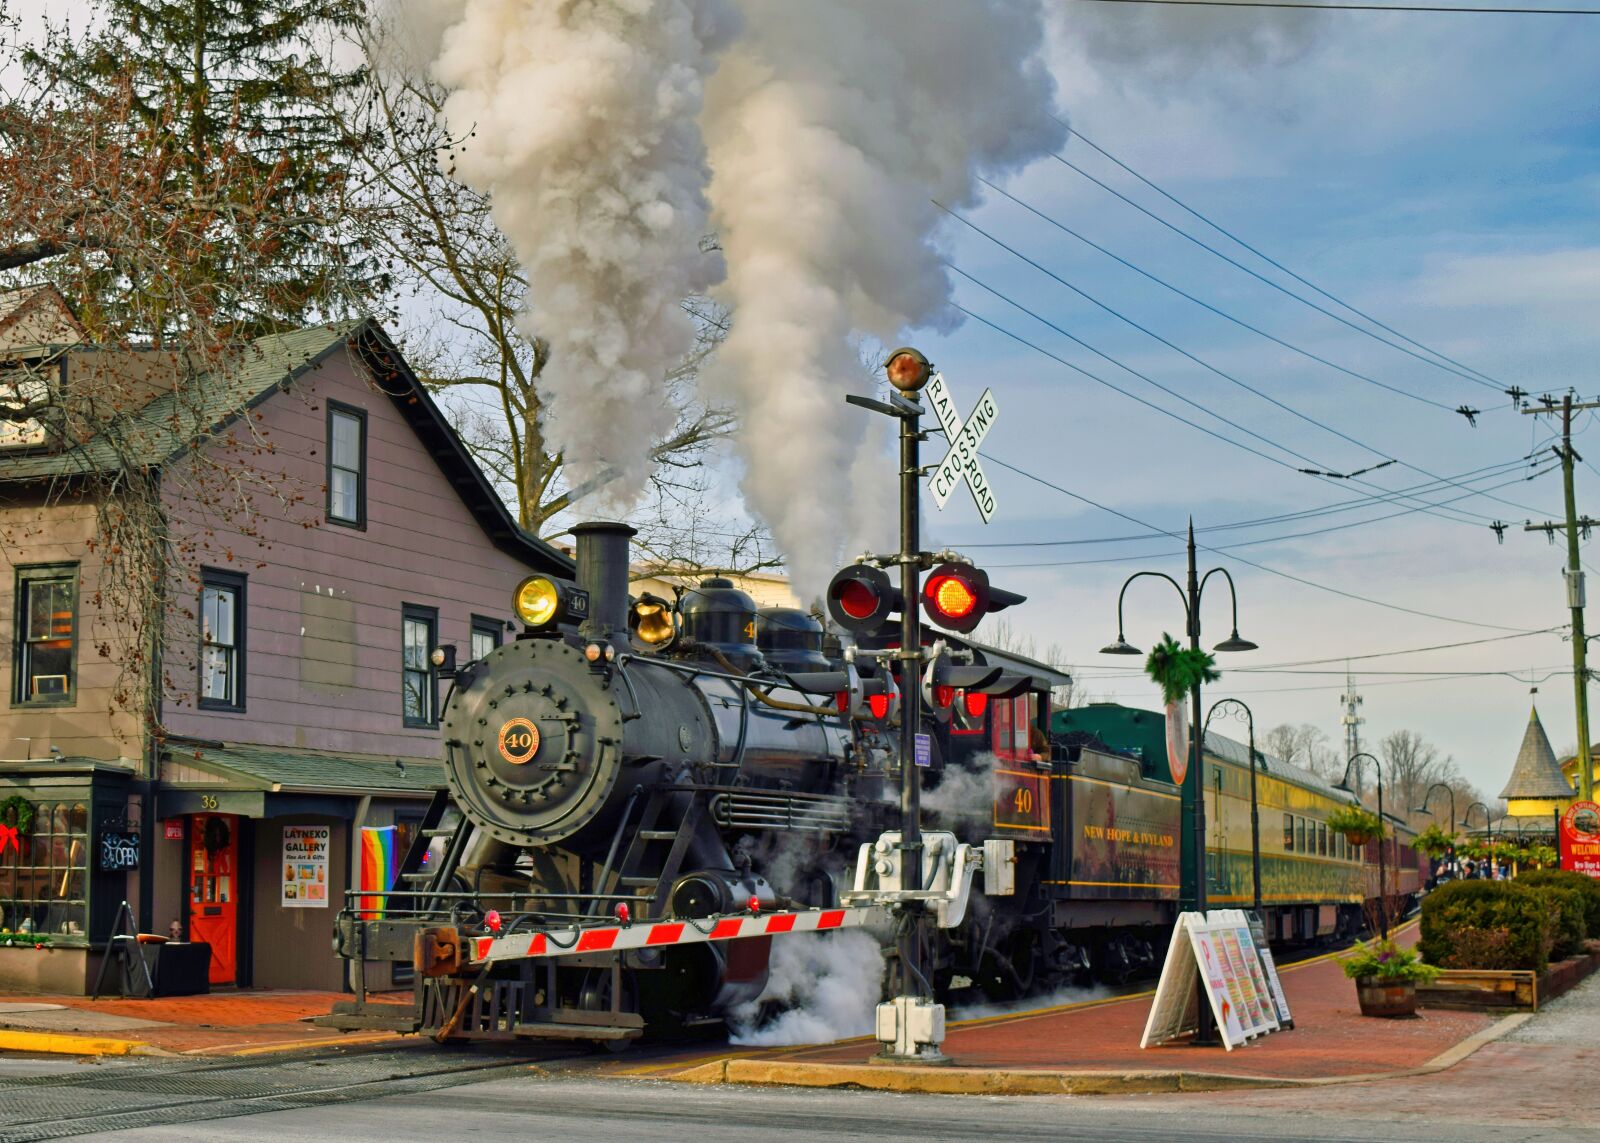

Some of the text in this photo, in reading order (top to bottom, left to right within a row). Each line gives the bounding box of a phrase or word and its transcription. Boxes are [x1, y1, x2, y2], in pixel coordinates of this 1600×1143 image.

[931, 379, 994, 514] RAIL ROAD
[936, 399, 994, 498] CROSSING
[571, 596, 586, 611] 40
[505, 733, 532, 748] 40
[201, 795, 217, 809] 36
[1014, 788, 1032, 814] 40
[284, 829, 328, 839] LATNEXO
[1084, 825, 1174, 847] NEW HOPE & IVYLAND
[285, 843, 327, 852] GALLERY
[115, 847, 139, 866] OPEN
